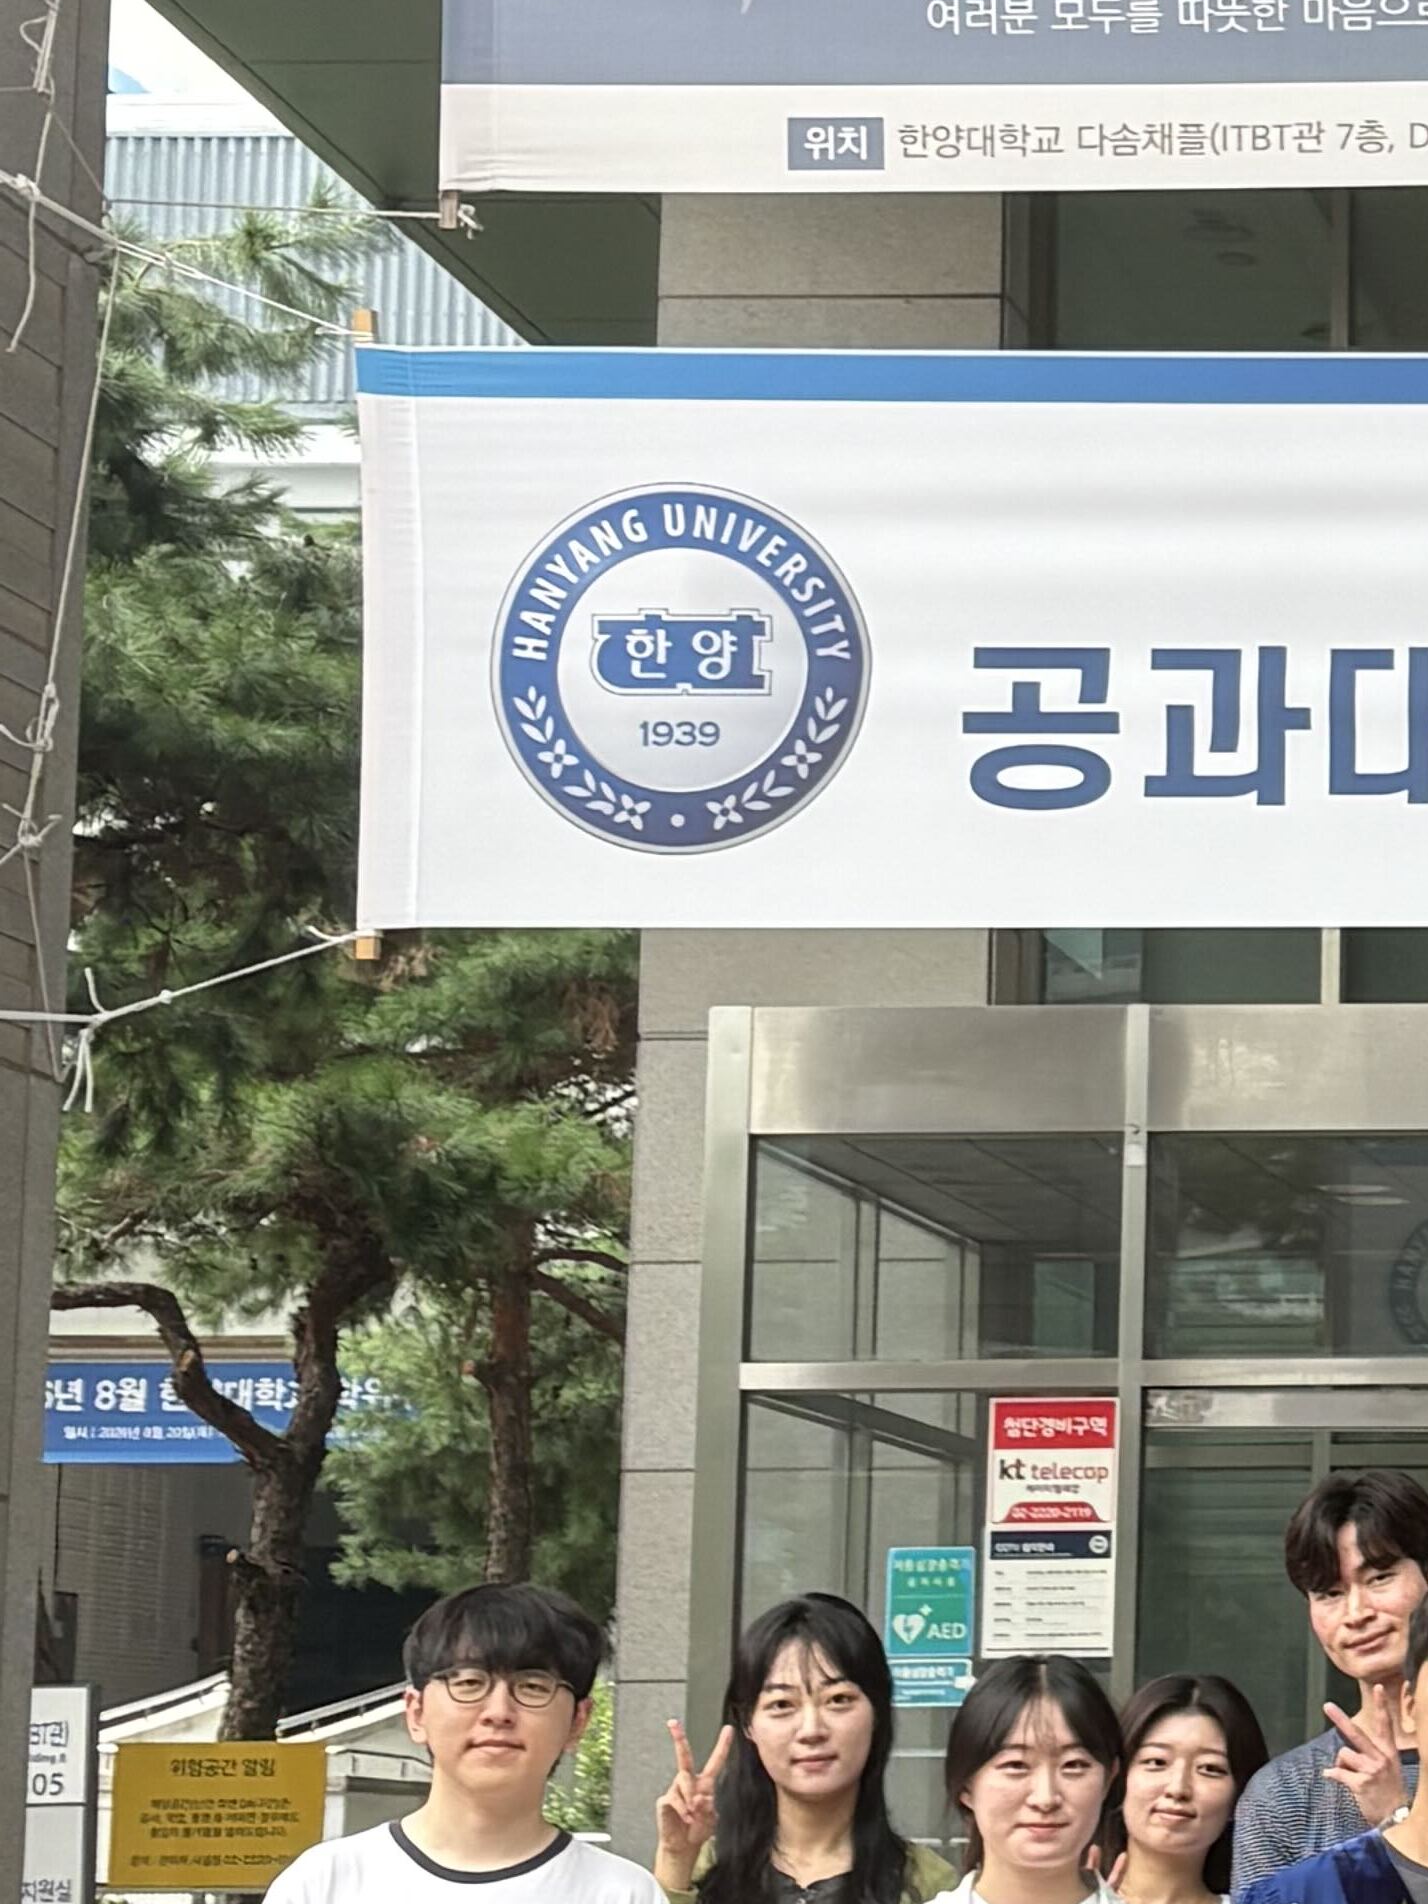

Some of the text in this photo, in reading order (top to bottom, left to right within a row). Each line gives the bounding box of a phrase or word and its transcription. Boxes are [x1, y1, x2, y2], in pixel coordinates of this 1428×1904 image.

[802, 125, 869, 162] 위치
[897, 123, 1065, 159] 한양대학교
[1077, 120, 1326, 157] 다솜채플(ITBT관
[1336, 119, 1395, 154] 7층,
[512, 502, 852, 662] HANYANG UNIVERSITY
[625, 627, 739, 681] 한양
[638, 720, 722, 747] 1939
[94, 1377, 149, 1413] 8월
[998, 1458, 1110, 1484] kt telecop
[926, 1622, 968, 1640] AED
[32, 1772, 65, 1796] 05
